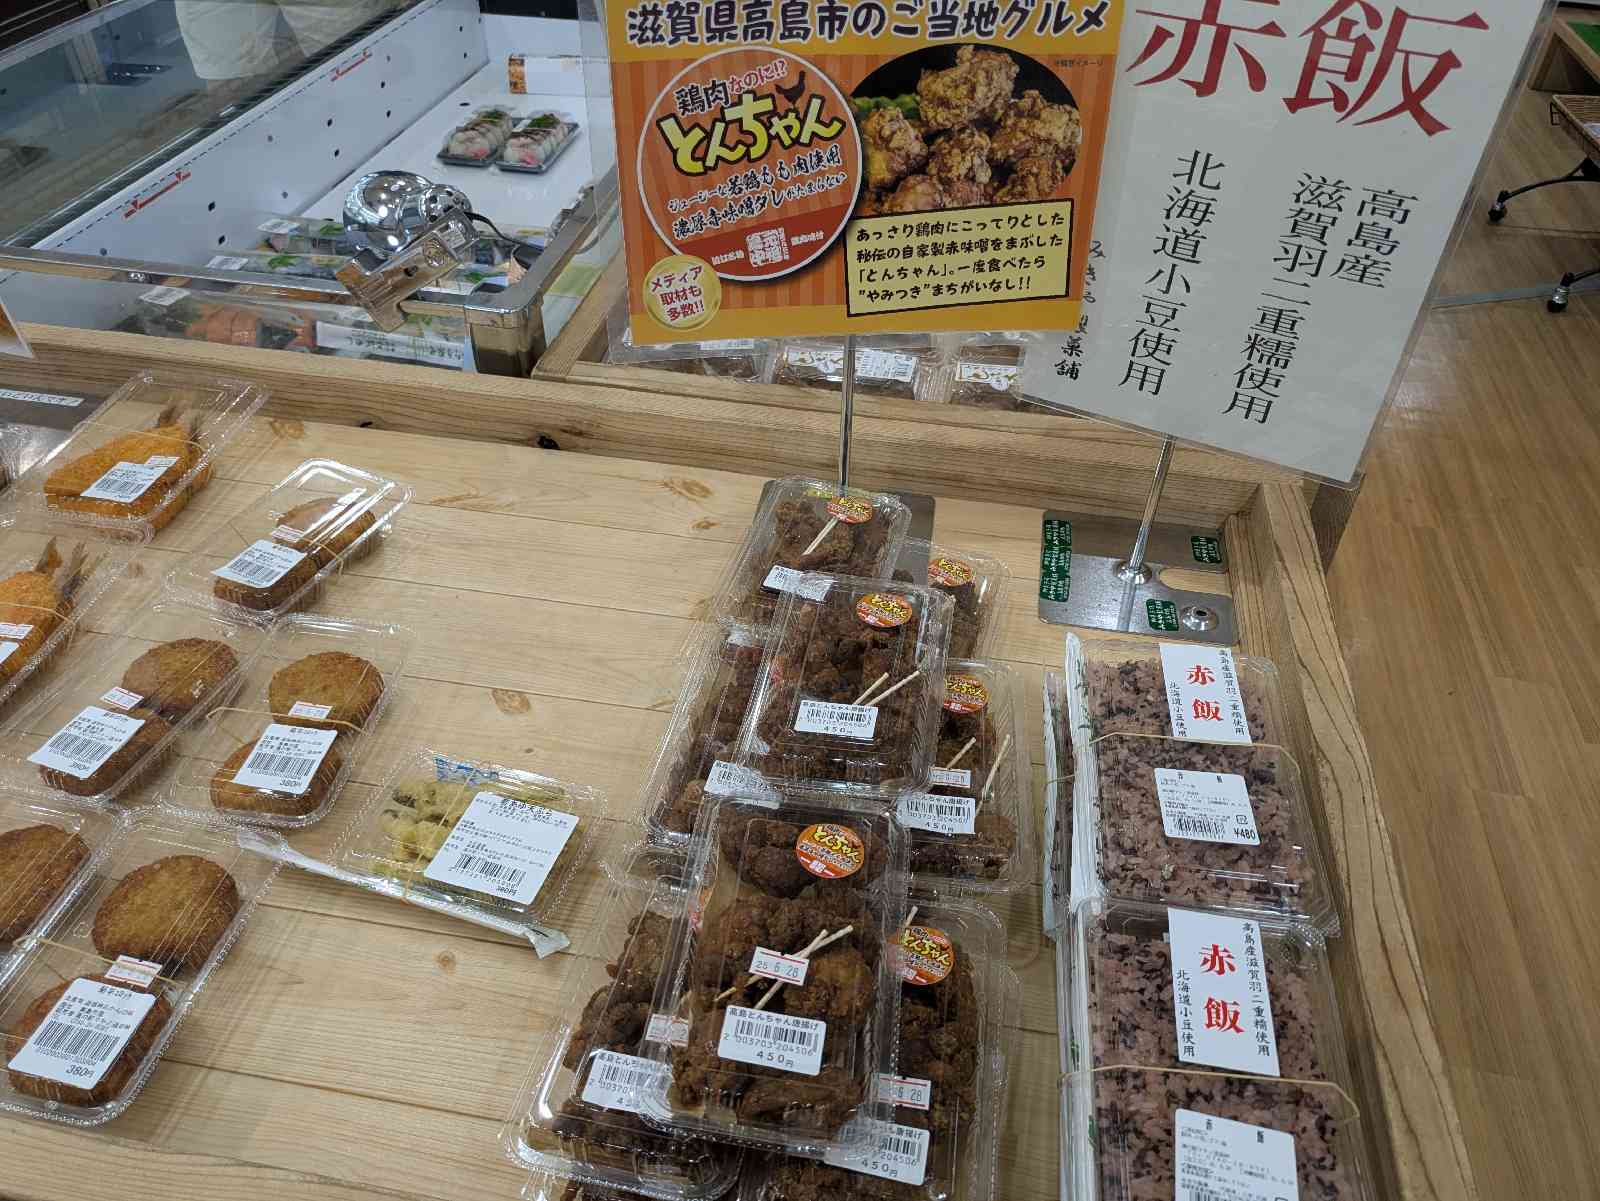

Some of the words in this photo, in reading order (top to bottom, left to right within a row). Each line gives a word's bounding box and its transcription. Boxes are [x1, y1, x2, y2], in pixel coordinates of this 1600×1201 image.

[628, 0, 1108, 44] 滋賀県高島市のご当地グルメ
[1125, 0, 1489, 137] 赤飯
[656, 91, 846, 176] とんちゃん
[856, 211, 1065, 242] あっさり鶏肉にこってりとした
[856, 233, 1063, 264] 秘伝の自家製赤味噌をまぶした
[1330, 185, 1418, 290] 高島産
[651, 265, 704, 293] メディア
[659, 285, 703, 306] 取材も
[859, 255, 1046, 283] 「とんちゃん」。一度食べたら
[1118, 148, 1228, 397] 北海道小豆使用
[1223, 172, 1352, 425] 滋賀羽二重糯使用
[1185, 664, 1223, 722] 赤飯
[1176, 969, 1196, 1057] 北海道小豆使用
[1199, 943, 1245, 1034] 赤飯
[756, 1050, 794, 1068] 450円
